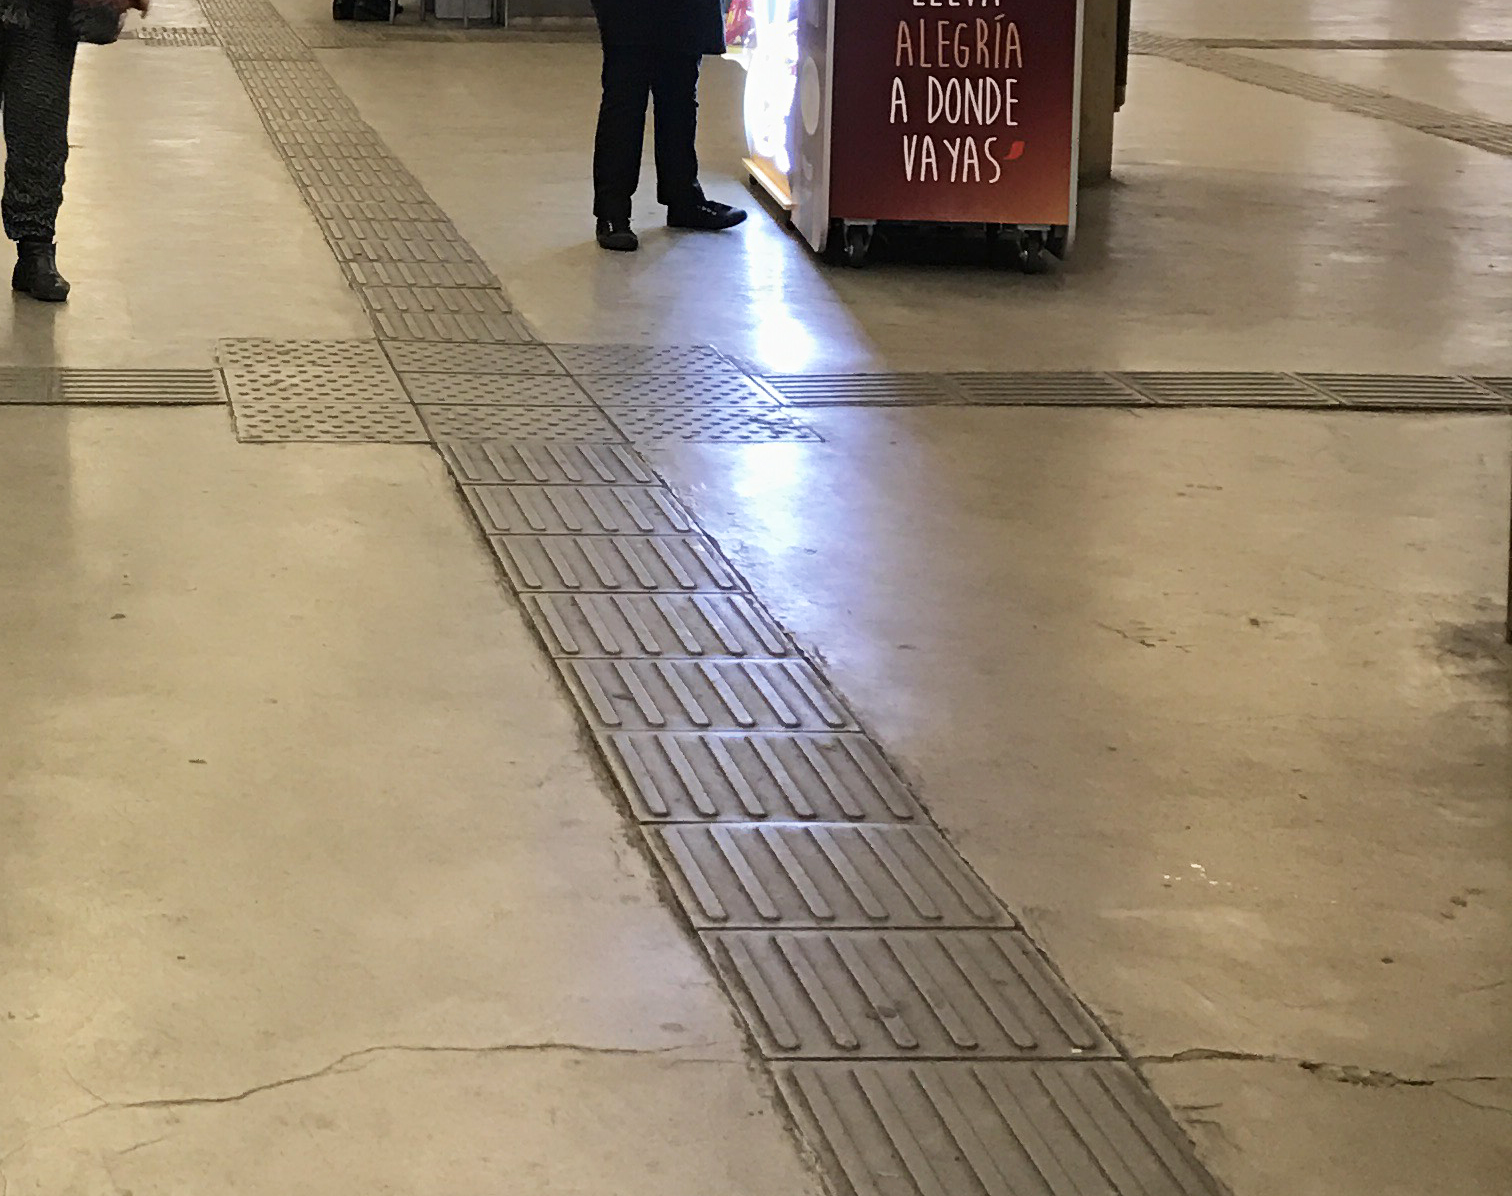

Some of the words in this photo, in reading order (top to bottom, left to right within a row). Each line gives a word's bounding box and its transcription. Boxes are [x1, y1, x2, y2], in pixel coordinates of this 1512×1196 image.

[895, 13, 1023, 69] ALEGRÍA
[889, 76, 908, 124] A
[927, 75, 1019, 126] DONDE
[903, 134, 1001, 184] VAYAS
